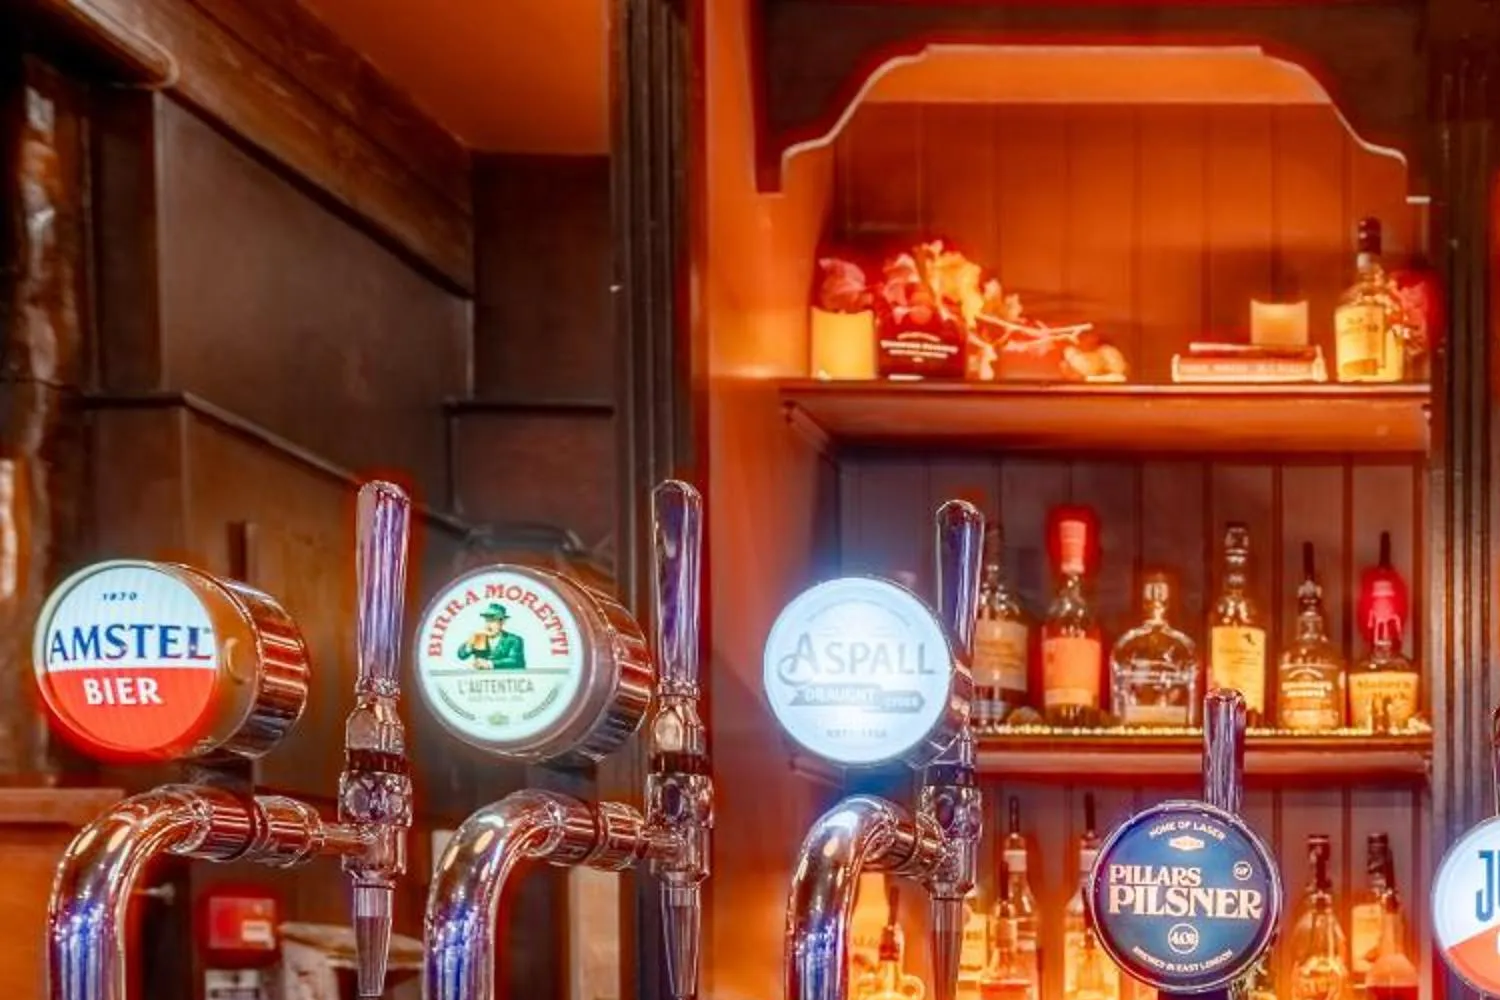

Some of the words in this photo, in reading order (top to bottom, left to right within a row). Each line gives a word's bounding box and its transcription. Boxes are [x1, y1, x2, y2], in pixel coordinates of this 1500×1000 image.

[427, 590, 480, 657] BIRRA
[484, 582, 570, 657] MORETTI
[49, 622, 212, 664] AMSTEL
[777, 631, 940, 687] ASPALL
[82, 676, 164, 706] BIER
[1148, 822, 1177, 838] HOME
[1108, 863, 1202, 887] PILLARS
[1108, 885, 1263, 920] PILSNER
